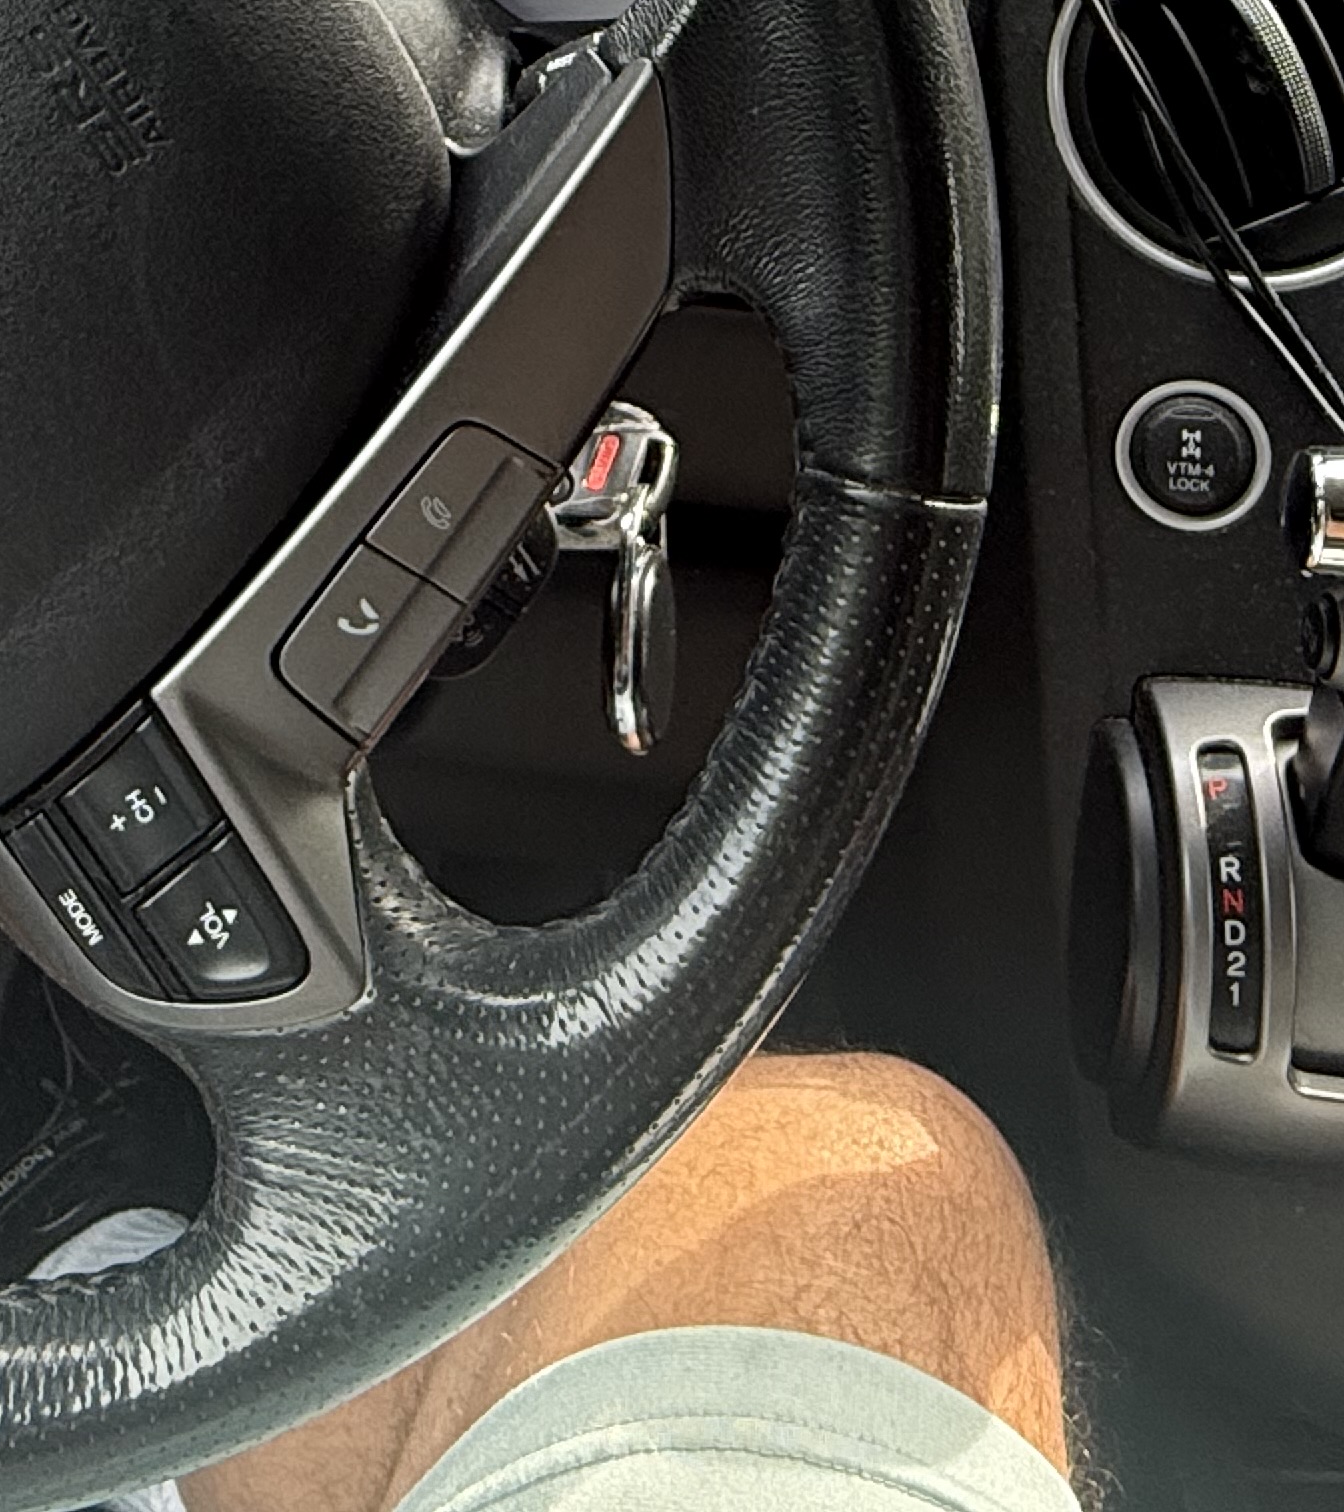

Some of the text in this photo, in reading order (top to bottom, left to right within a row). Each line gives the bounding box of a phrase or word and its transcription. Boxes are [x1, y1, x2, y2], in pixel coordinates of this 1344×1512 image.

[1167, 461, 1215, 478] VTM-4
[1169, 477, 1210, 493] LOCK
[1207, 778, 1228, 800] P
[125, 788, 155, 824] CH
[1219, 856, 1242, 882] R
[1222, 888, 1244, 914] N
[58, 889, 103, 946] MODE
[198, 902, 232, 951] VOL
[1224, 920, 1246, 946] D
[1226, 951, 1246, 977] 2
[1229, 981, 1241, 1007] 1
